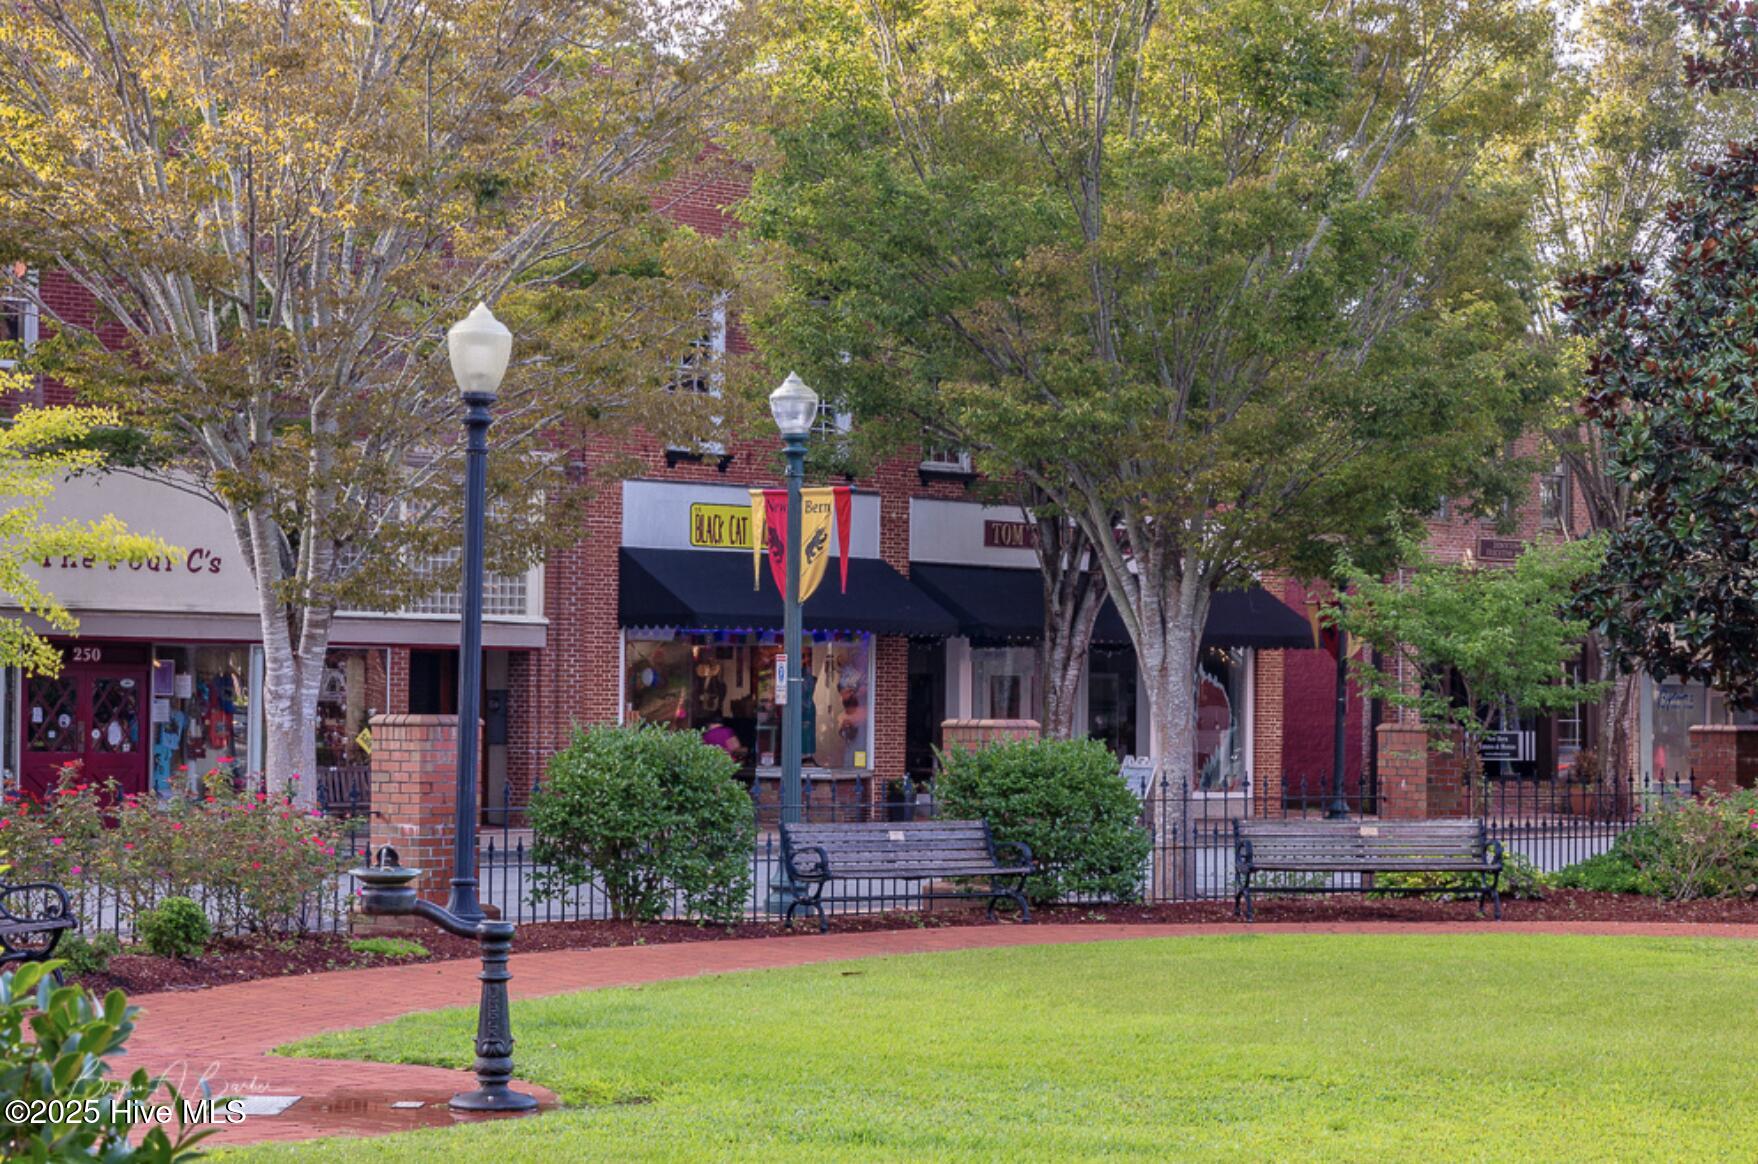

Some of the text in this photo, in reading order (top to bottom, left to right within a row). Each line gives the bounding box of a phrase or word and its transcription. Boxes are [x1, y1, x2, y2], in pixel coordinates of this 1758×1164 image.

[767, 500, 831, 514] New Bern
[694, 513, 724, 544] BLACK
[729, 515, 748, 545] CAT
[187, 548, 222, 574] C's
[73, 647, 101, 662] 250
